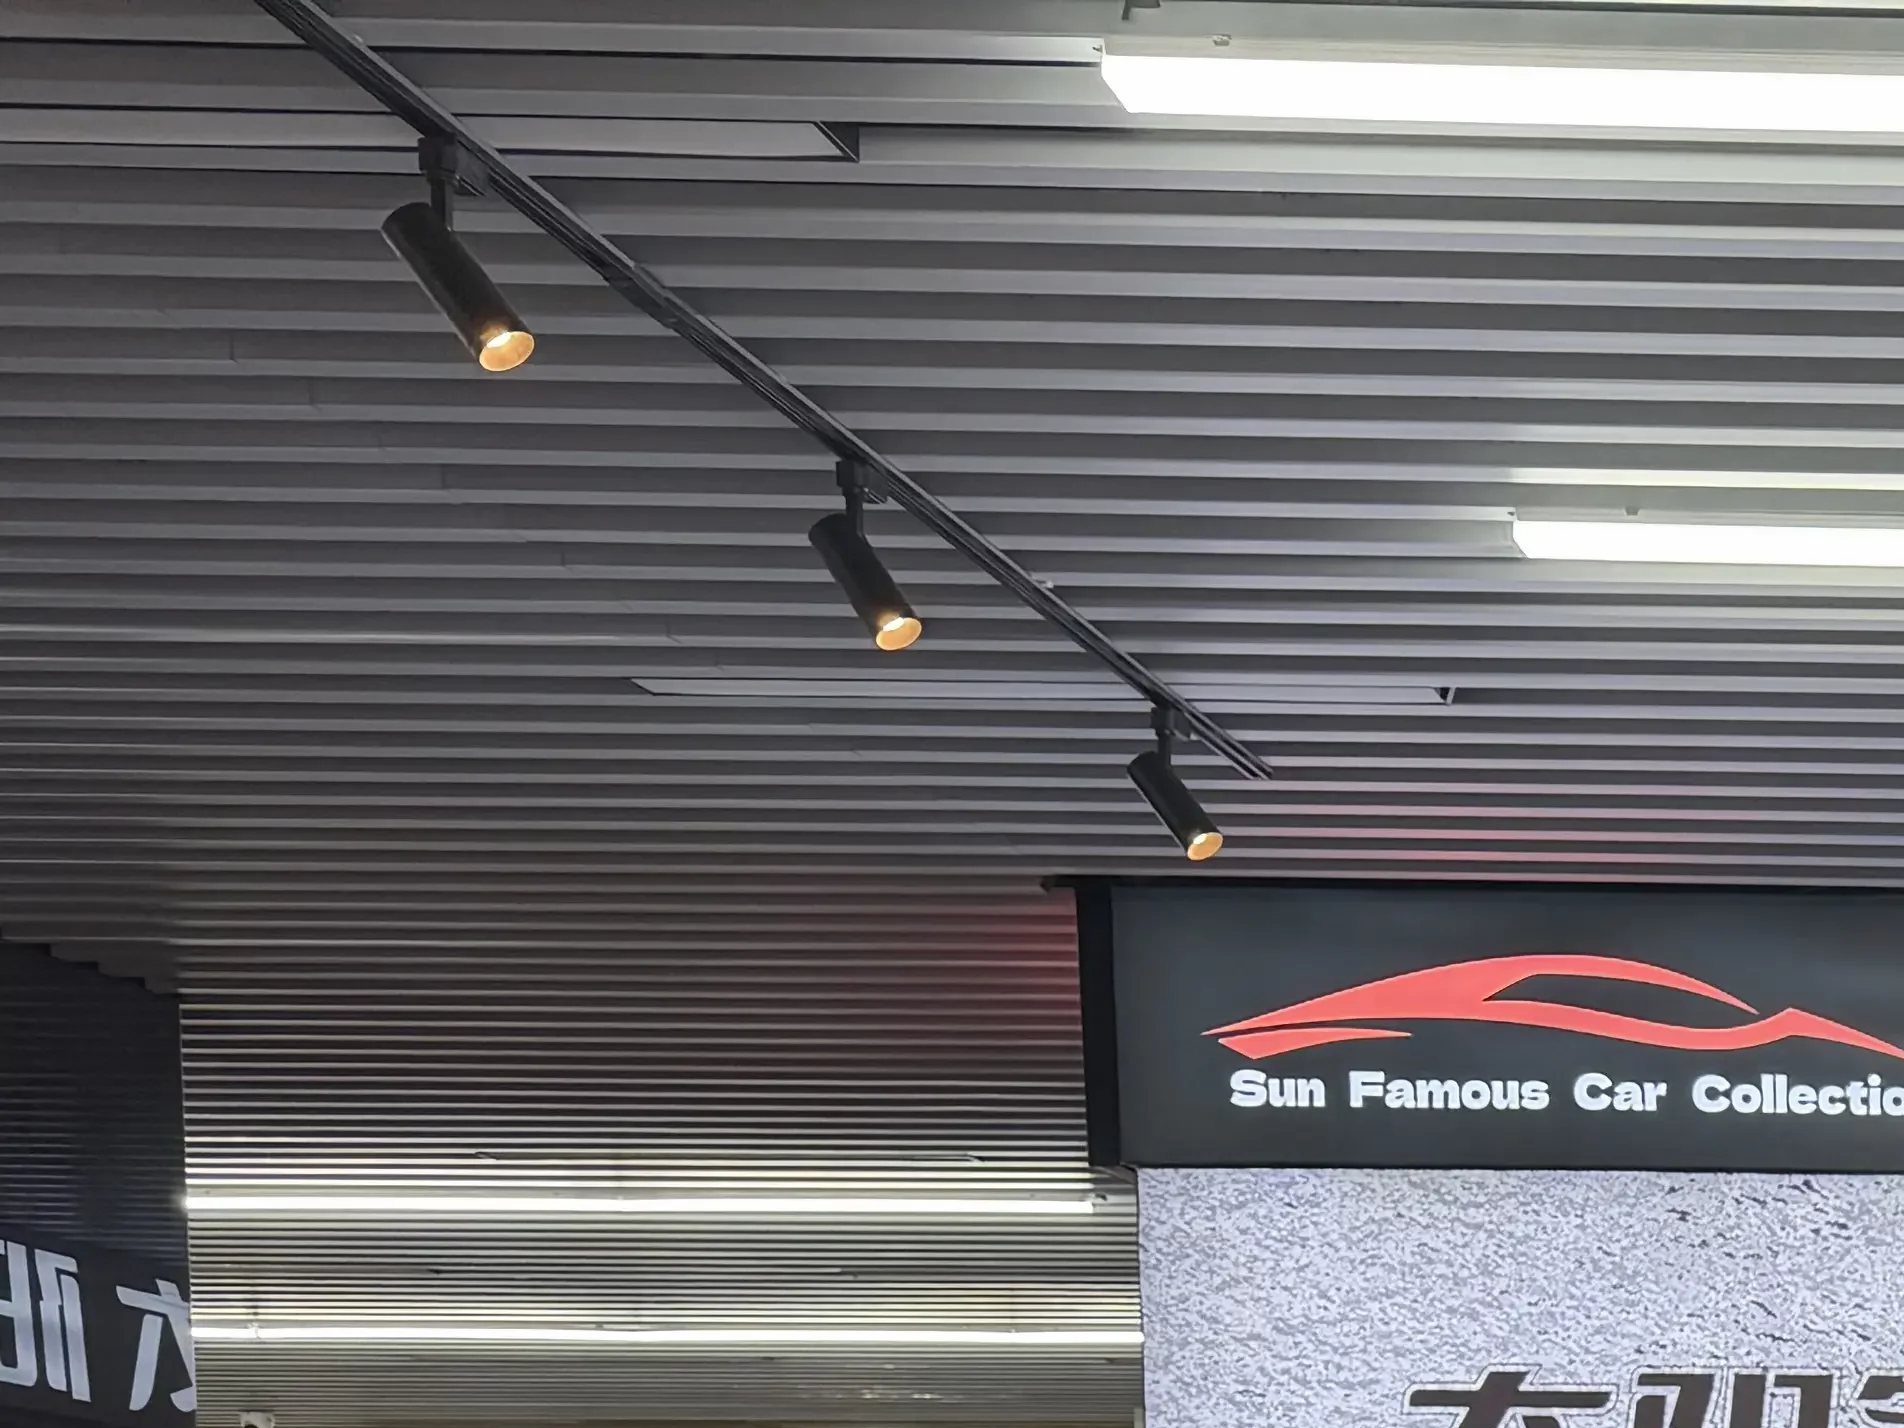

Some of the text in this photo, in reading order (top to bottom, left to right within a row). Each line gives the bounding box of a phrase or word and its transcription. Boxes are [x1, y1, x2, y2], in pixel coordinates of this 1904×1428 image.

[1229, 1069, 1327, 1109] Sun
[1348, 1070, 1550, 1112] Famous
[1574, 1072, 1667, 1113] Car
